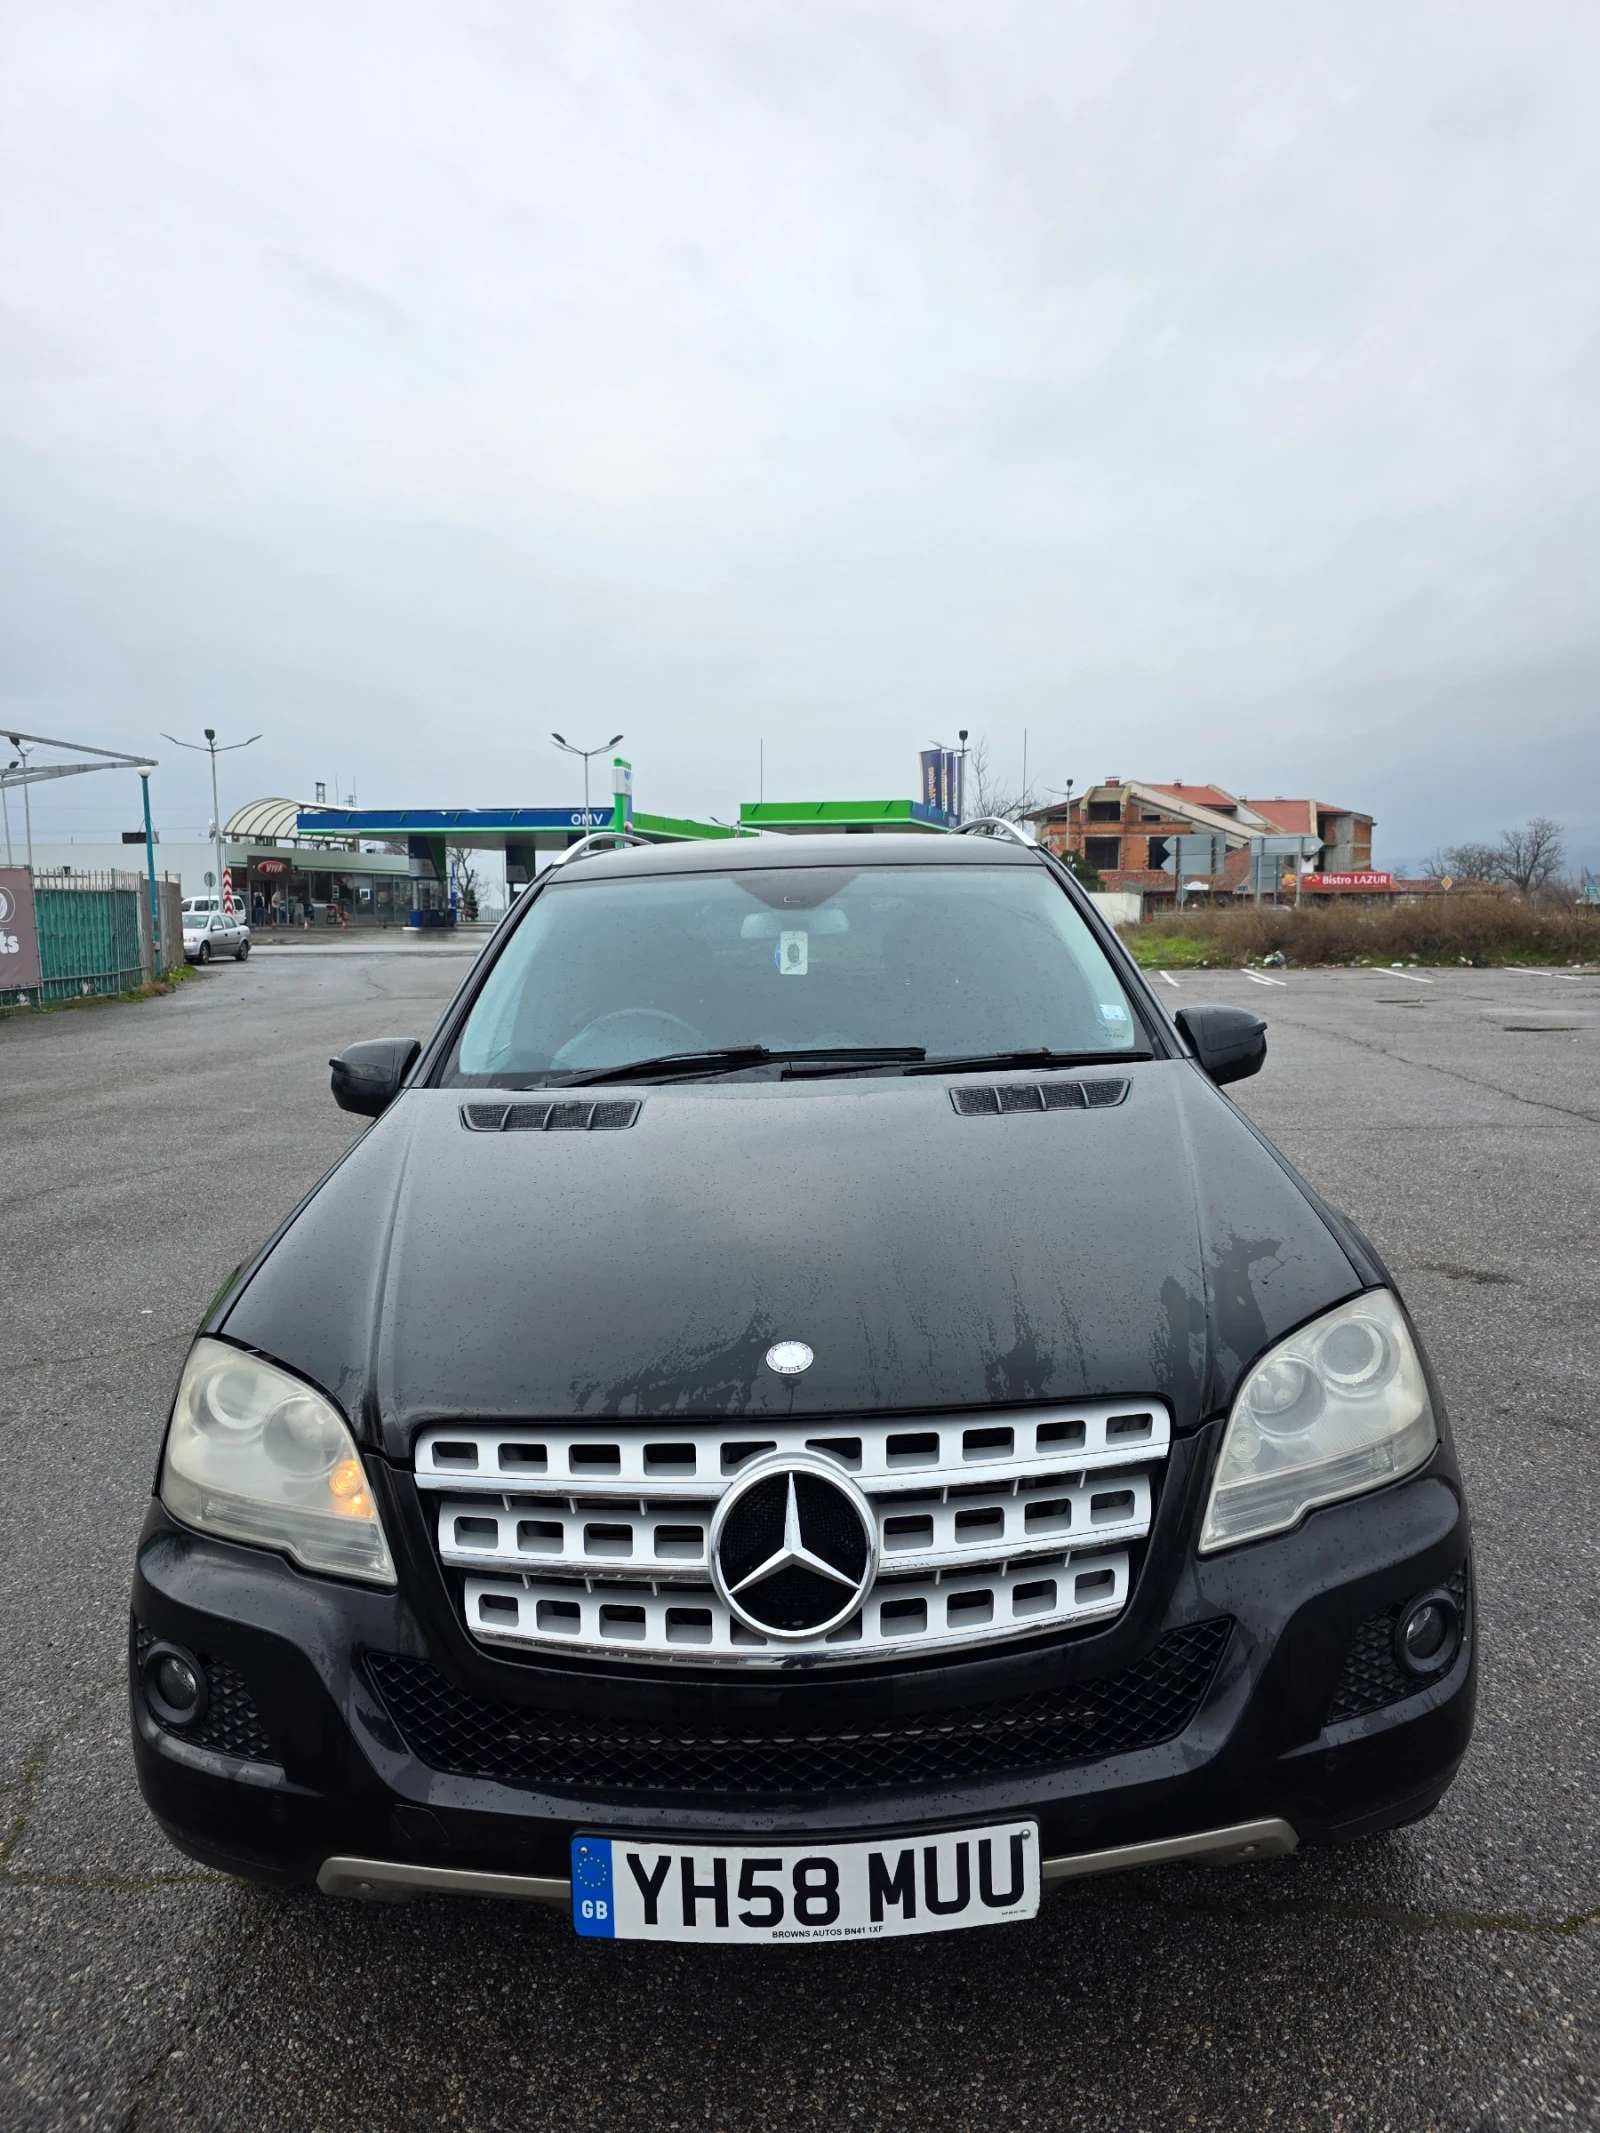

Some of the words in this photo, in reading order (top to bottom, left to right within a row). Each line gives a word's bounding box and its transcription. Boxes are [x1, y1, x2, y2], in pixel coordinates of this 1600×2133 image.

[571, 813, 604, 825] OMV
[266, 864, 283, 873] VIVA
[1322, 874, 1351, 884] Bistro
[1354, 875, 1387, 884] LAZUR
[626, 1853, 840, 1927] YH58
[868, 1834, 1026, 1922] MUU
[581, 1900, 609, 1920] GB
[772, 1930, 811, 1938] BROWNS
[812, 1929, 842, 1937] AUTOS
[844, 1926, 866, 1935] BN41
[868, 1925, 884, 1933] 1XF
